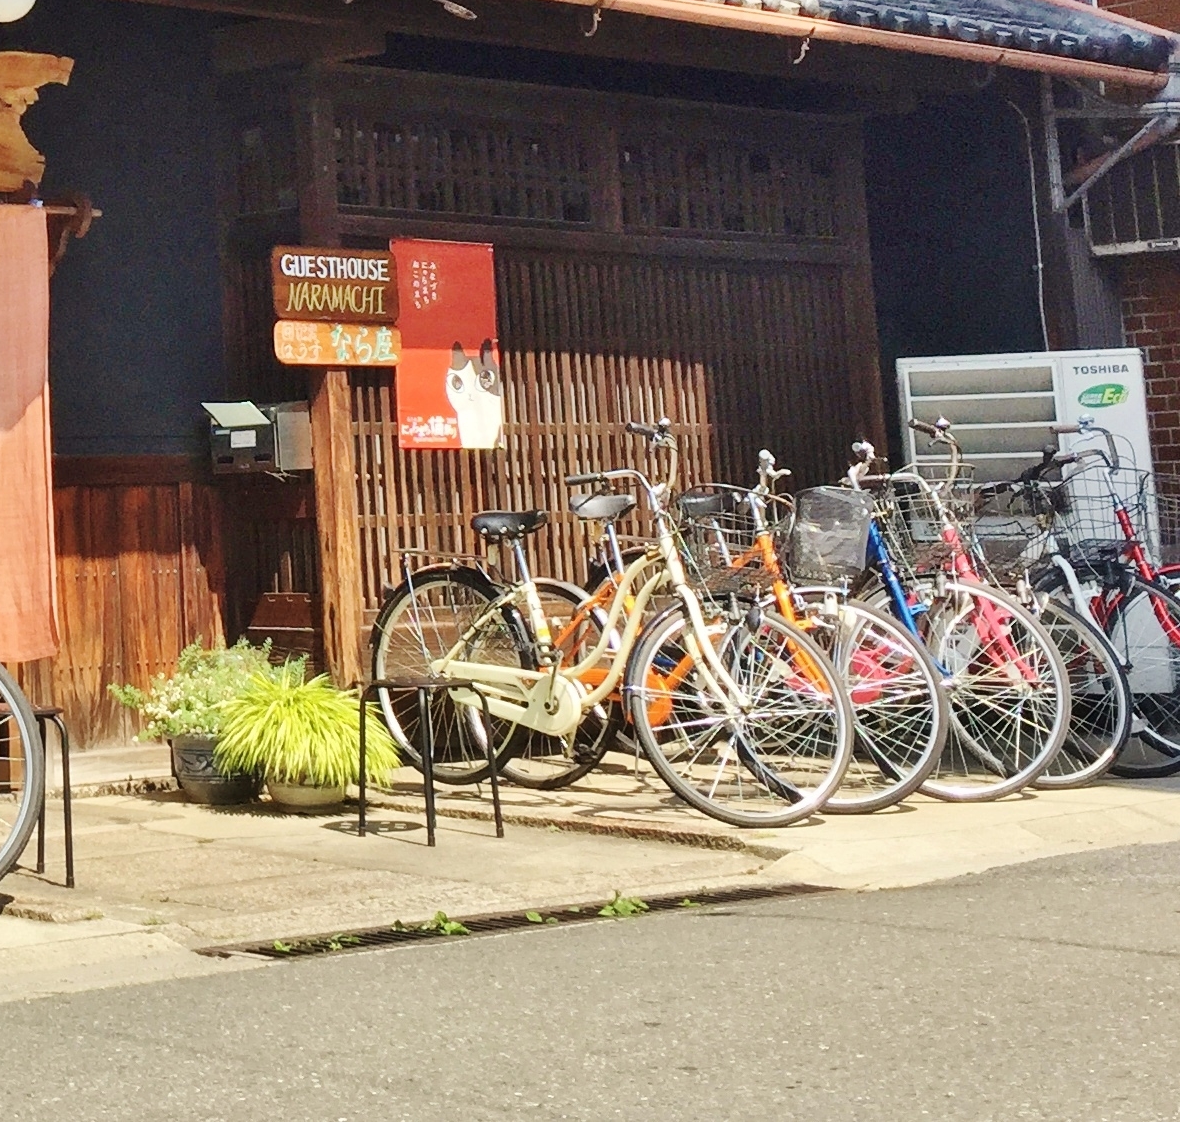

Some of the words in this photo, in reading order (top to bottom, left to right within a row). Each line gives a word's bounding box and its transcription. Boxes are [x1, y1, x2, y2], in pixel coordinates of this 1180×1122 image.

[280, 253, 391, 282] GUESTHOUSE
[286, 282, 386, 315] NARAMACHI
[330, 323, 398, 364] なら座
[1072, 364, 1129, 375] TOSHIBA
